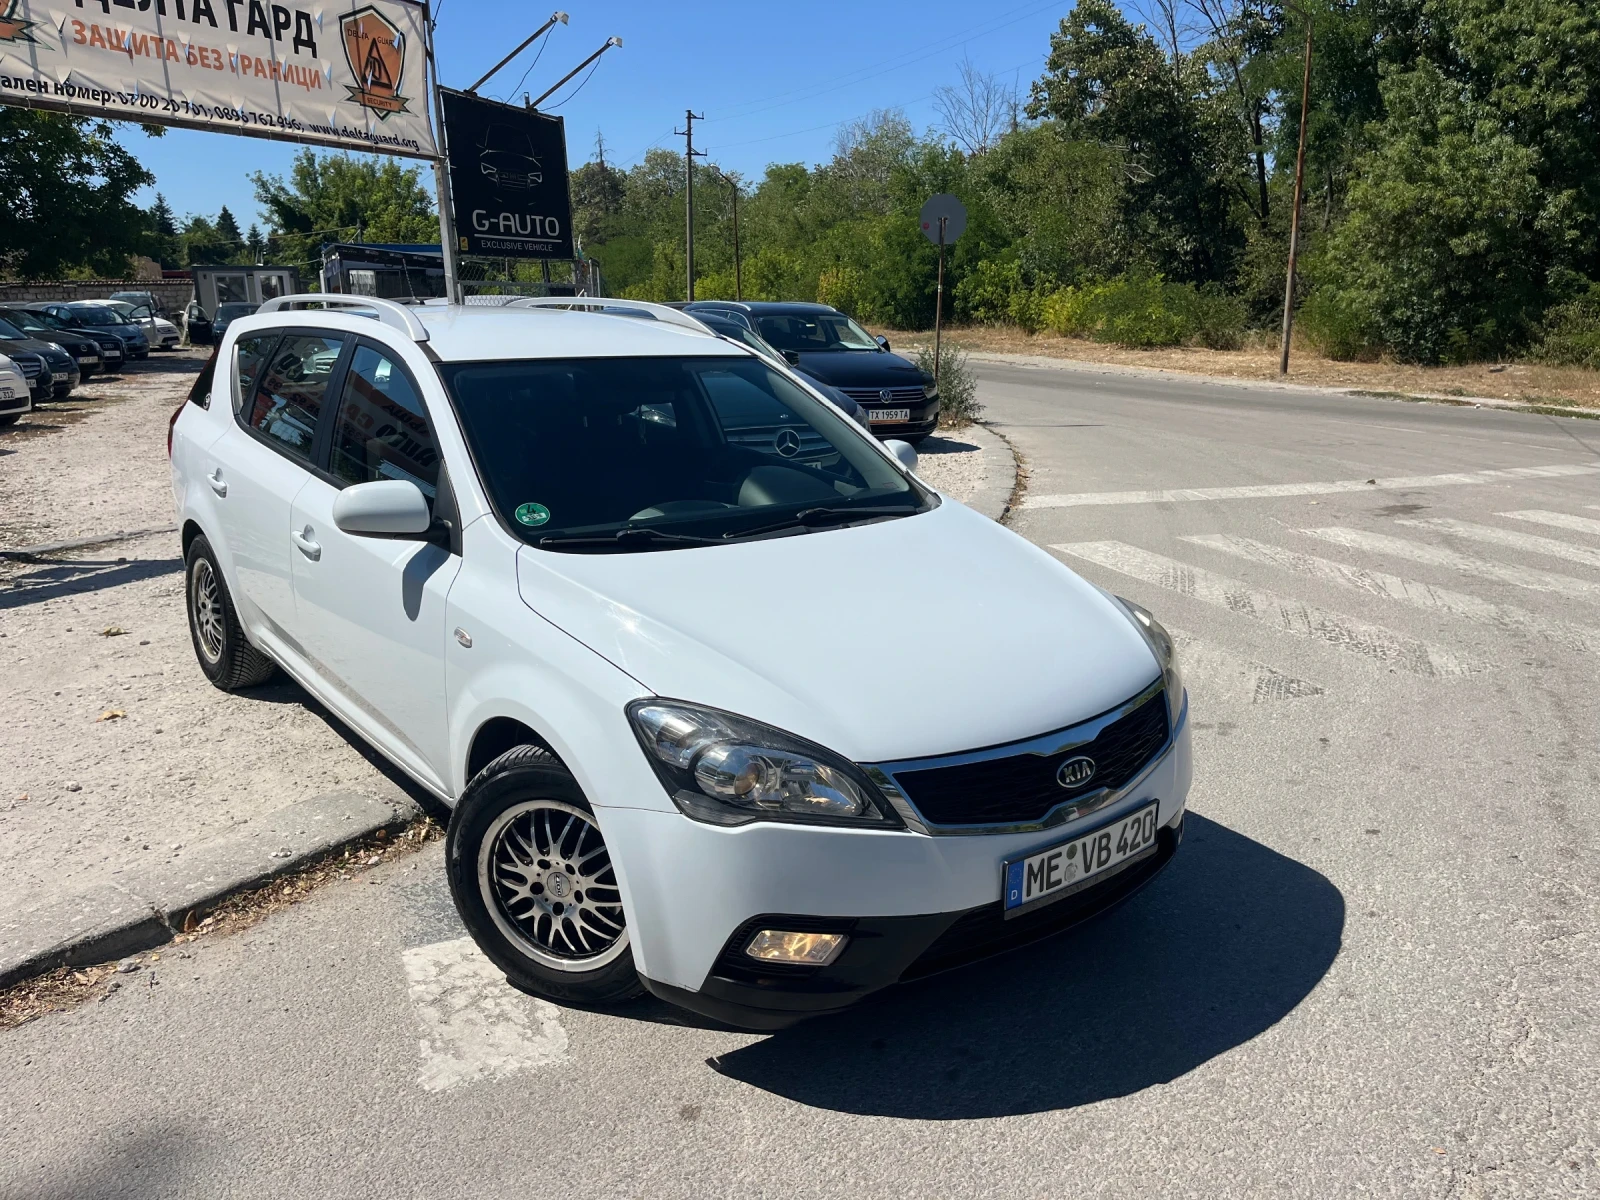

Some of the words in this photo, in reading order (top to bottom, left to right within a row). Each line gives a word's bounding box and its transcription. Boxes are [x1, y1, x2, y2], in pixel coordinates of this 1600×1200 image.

[226, 0, 317, 58] ГАРД
[71, 20, 180, 62] ЗАЩИТА
[181, 42, 224, 71] БЕЗ
[377, 36, 394, 47] GUAR
[0, 75, 48, 93] ален
[309, 124, 420, 152] www.deltaguard.org
[472, 209, 560, 236] G-AUTO
[481, 240, 523, 250] EXCLUSIVE
[524, 242, 553, 251] VEHICLE
[870, 411, 880, 419] TX
[881, 410, 898, 419] 1959
[899, 410, 909, 419] TA
[1063, 761, 1092, 783] KIA
[1026, 851, 1062, 897] ME
[1081, 832, 1112, 873] VB
[1116, 810, 1153, 856] 420
[1011, 890, 1018, 900] D
